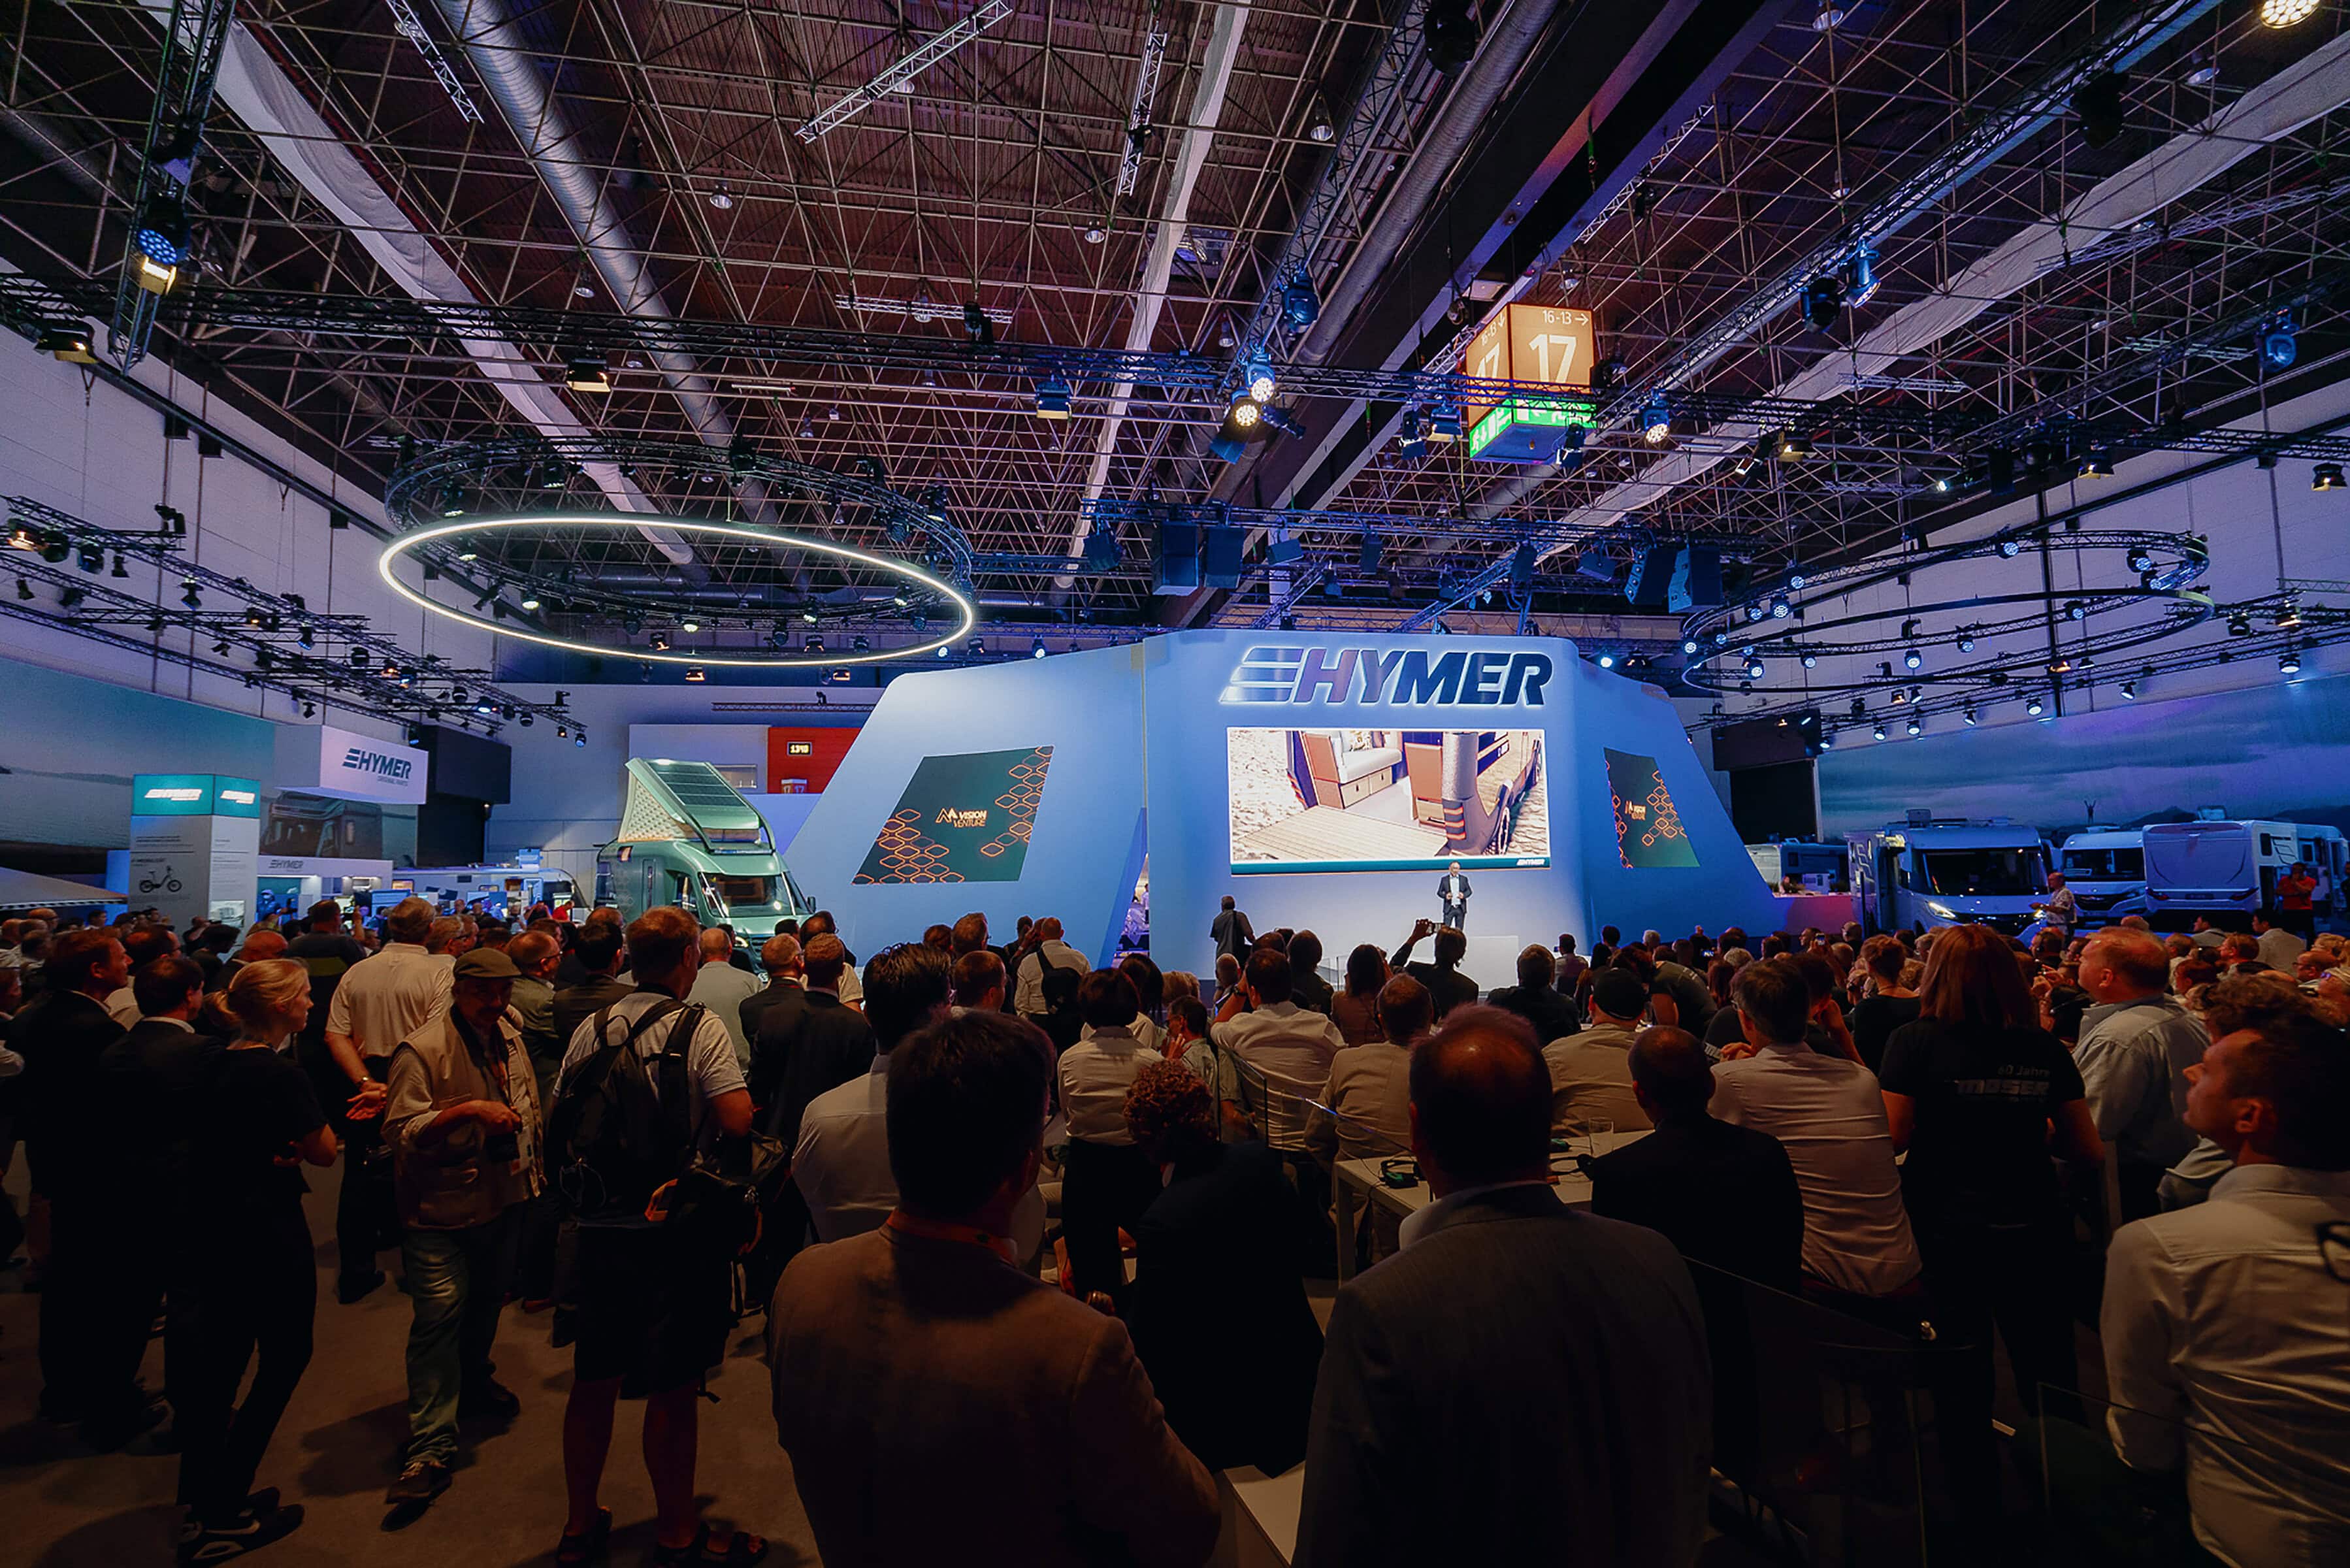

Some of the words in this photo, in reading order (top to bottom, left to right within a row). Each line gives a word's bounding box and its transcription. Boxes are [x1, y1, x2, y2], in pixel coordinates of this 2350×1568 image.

[1542, 310, 1572, 325] 16-13
[1529, 334, 1577, 383] 17
[1292, 647, 1553, 706] HYMER
[357, 751, 412, 779] HYMER
[958, 810, 987, 820] VISION
